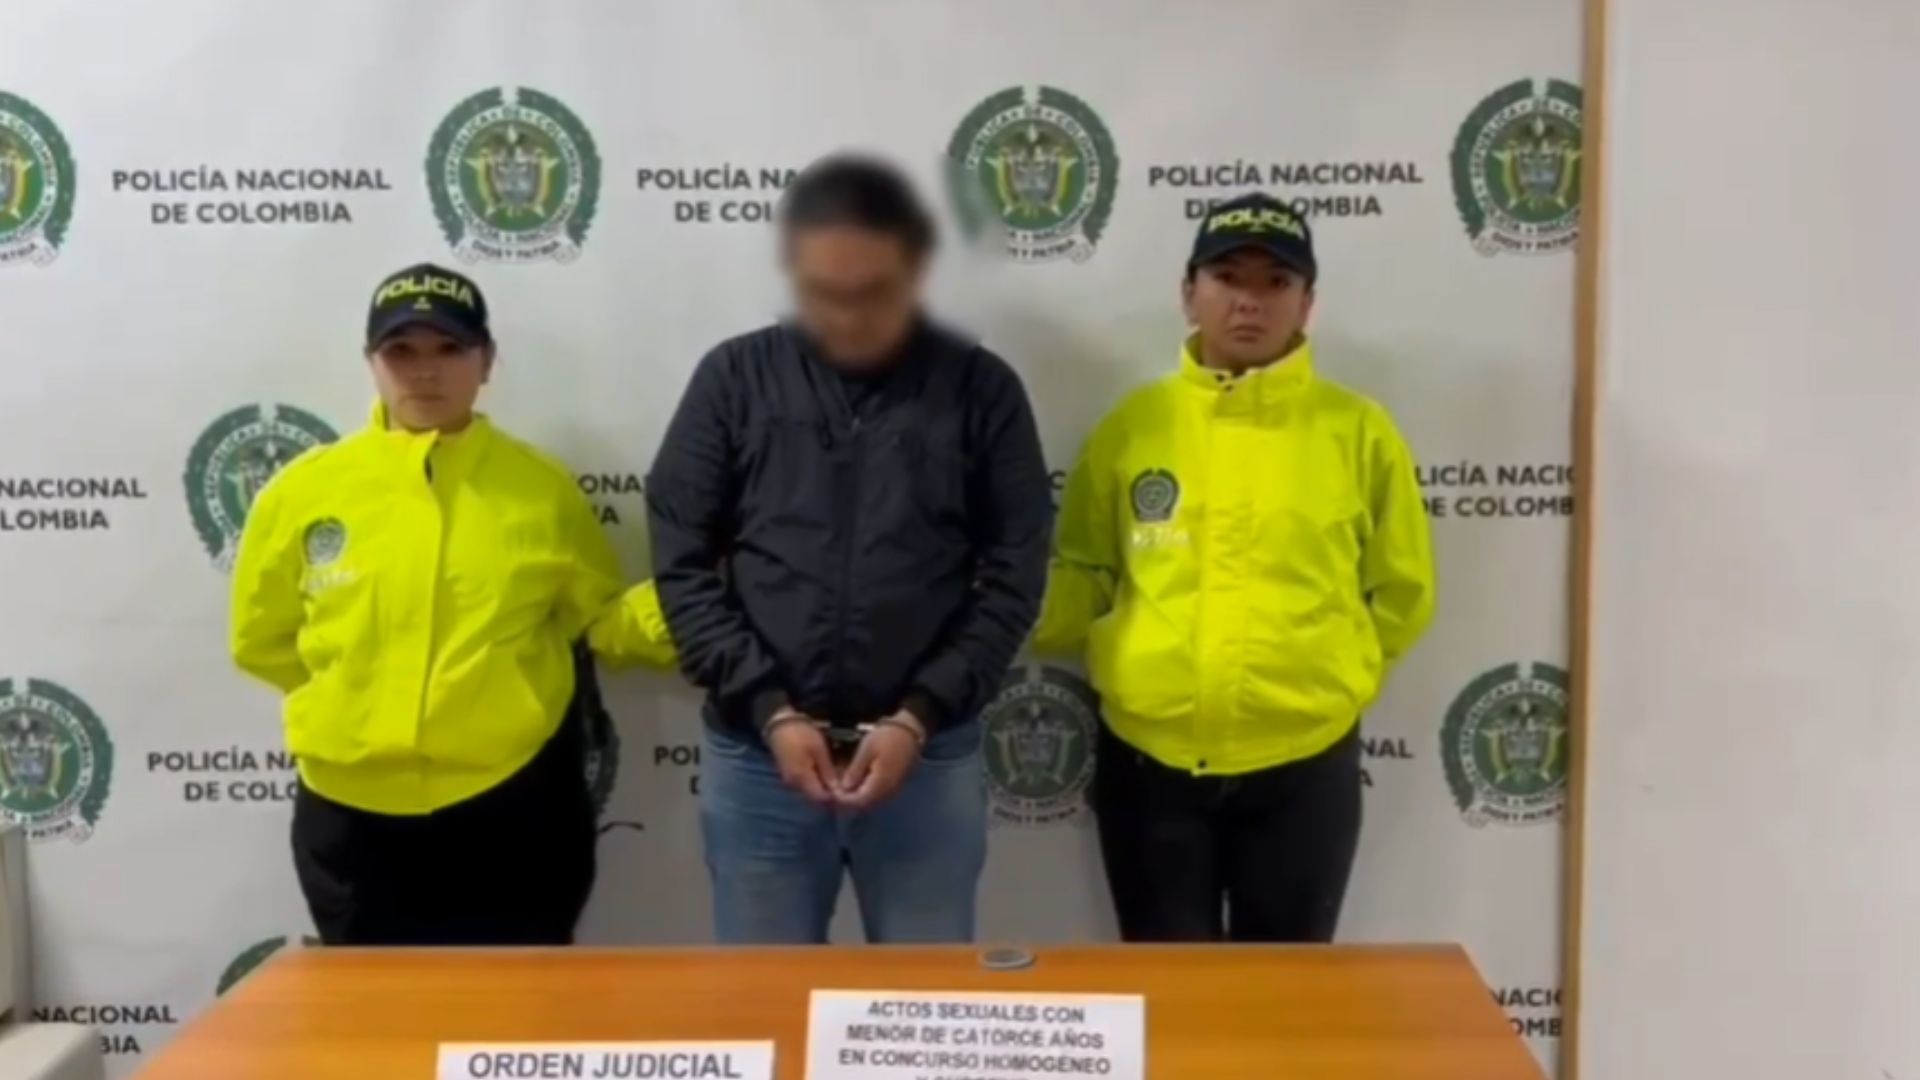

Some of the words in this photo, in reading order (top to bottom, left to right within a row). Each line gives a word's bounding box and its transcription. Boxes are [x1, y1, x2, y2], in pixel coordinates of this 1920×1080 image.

[112, 165, 228, 191] POLICÍA
[236, 169, 392, 190] NACIONAL
[637, 162, 752, 190] POLICÍA
[1149, 160, 1263, 187] POLICÍA
[1271, 162, 1423, 185] NACIONAL
[151, 203, 188, 224] DE
[196, 202, 352, 224] COLOMBIA
[674, 202, 711, 223] DE
[1290, 196, 1382, 218] OMBIA
[1414, 461, 1487, 486] LICÍA
[1497, 465, 1574, 486] NACI
[0, 477, 147, 498] NACIONAL
[1454, 496, 1573, 517] COLOMB
[0, 508, 109, 530] LOMBIA
[148, 745, 258, 771] POLICÍA
[184, 782, 220, 801] DE
[228, 781, 298, 801] COLO
[32, 1004, 178, 1025] NACIONAL
[868, 1001, 933, 1018] ACTOS
[937, 1002, 1038, 1022] SEXUALES
[1043, 1007, 1085, 1023] CON
[846, 1024, 916, 1042] MENOR
[920, 1026, 946, 1044] DE
[952, 1028, 1043, 1047] CATORCE
[1049, 1028, 1104, 1049] AÑOS
[468, 1053, 584, 1079] ORDEN
[592, 1053, 742, 1079] JUDICIAL
[838, 1048, 865, 1065] EN
[870, 1050, 979, 1069] CONCURSO
